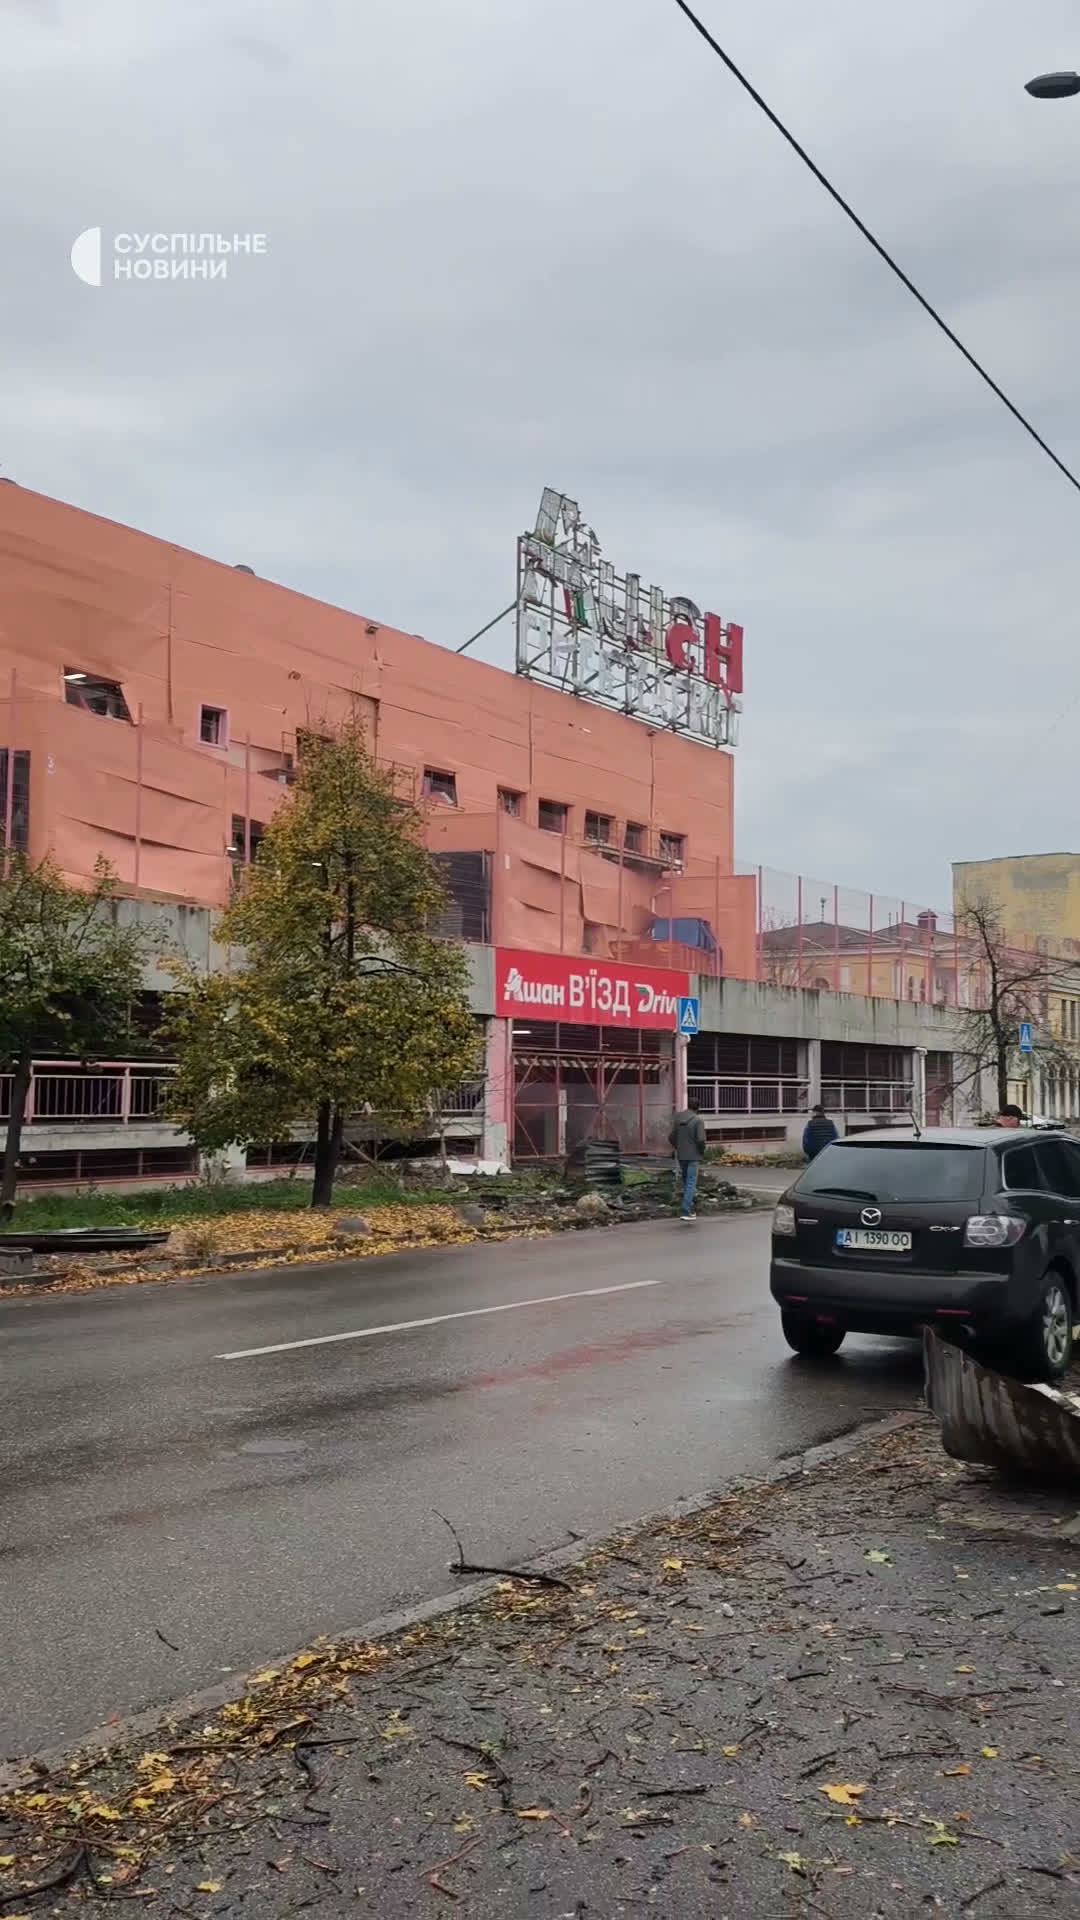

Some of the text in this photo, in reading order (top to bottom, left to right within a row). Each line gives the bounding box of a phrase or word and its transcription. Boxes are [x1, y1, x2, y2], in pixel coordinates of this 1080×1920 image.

[504, 968, 565, 1006] Ашан
[635, 984, 681, 1015] Driv
[864, 1231, 889, 1246] 1390
